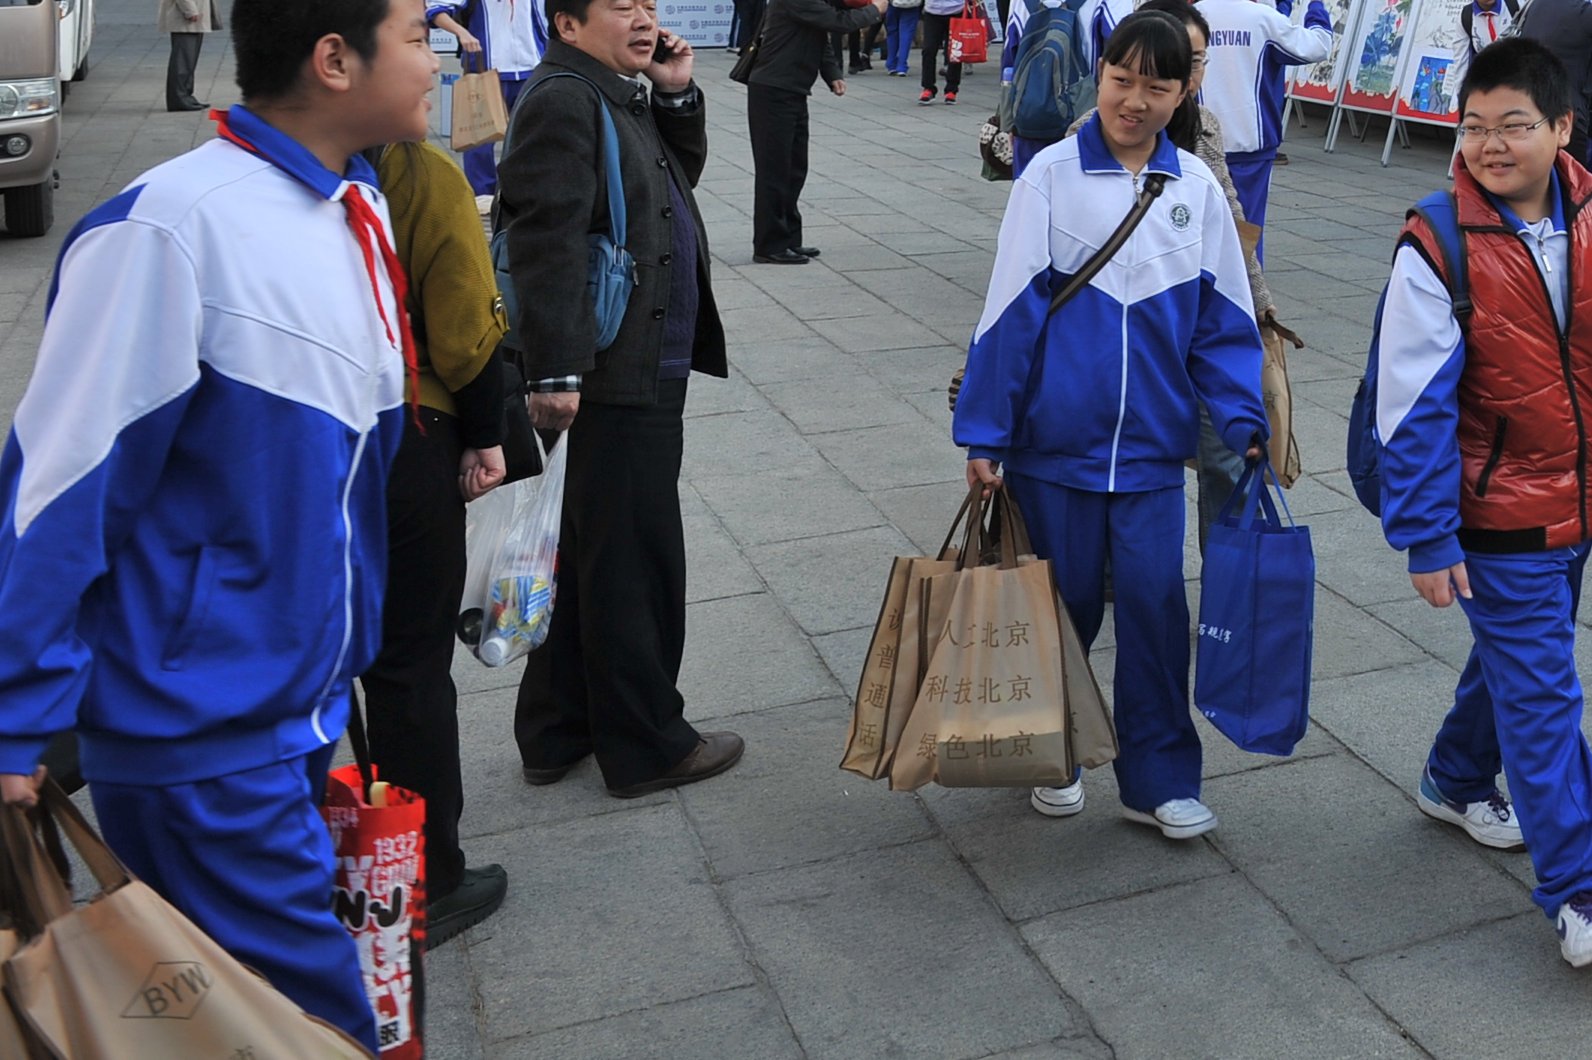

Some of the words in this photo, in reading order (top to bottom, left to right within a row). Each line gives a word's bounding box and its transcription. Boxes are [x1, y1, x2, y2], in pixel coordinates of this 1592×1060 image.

[925, 674, 1032, 705] 科技北京
[916, 730, 1036, 761] 绿色北京
